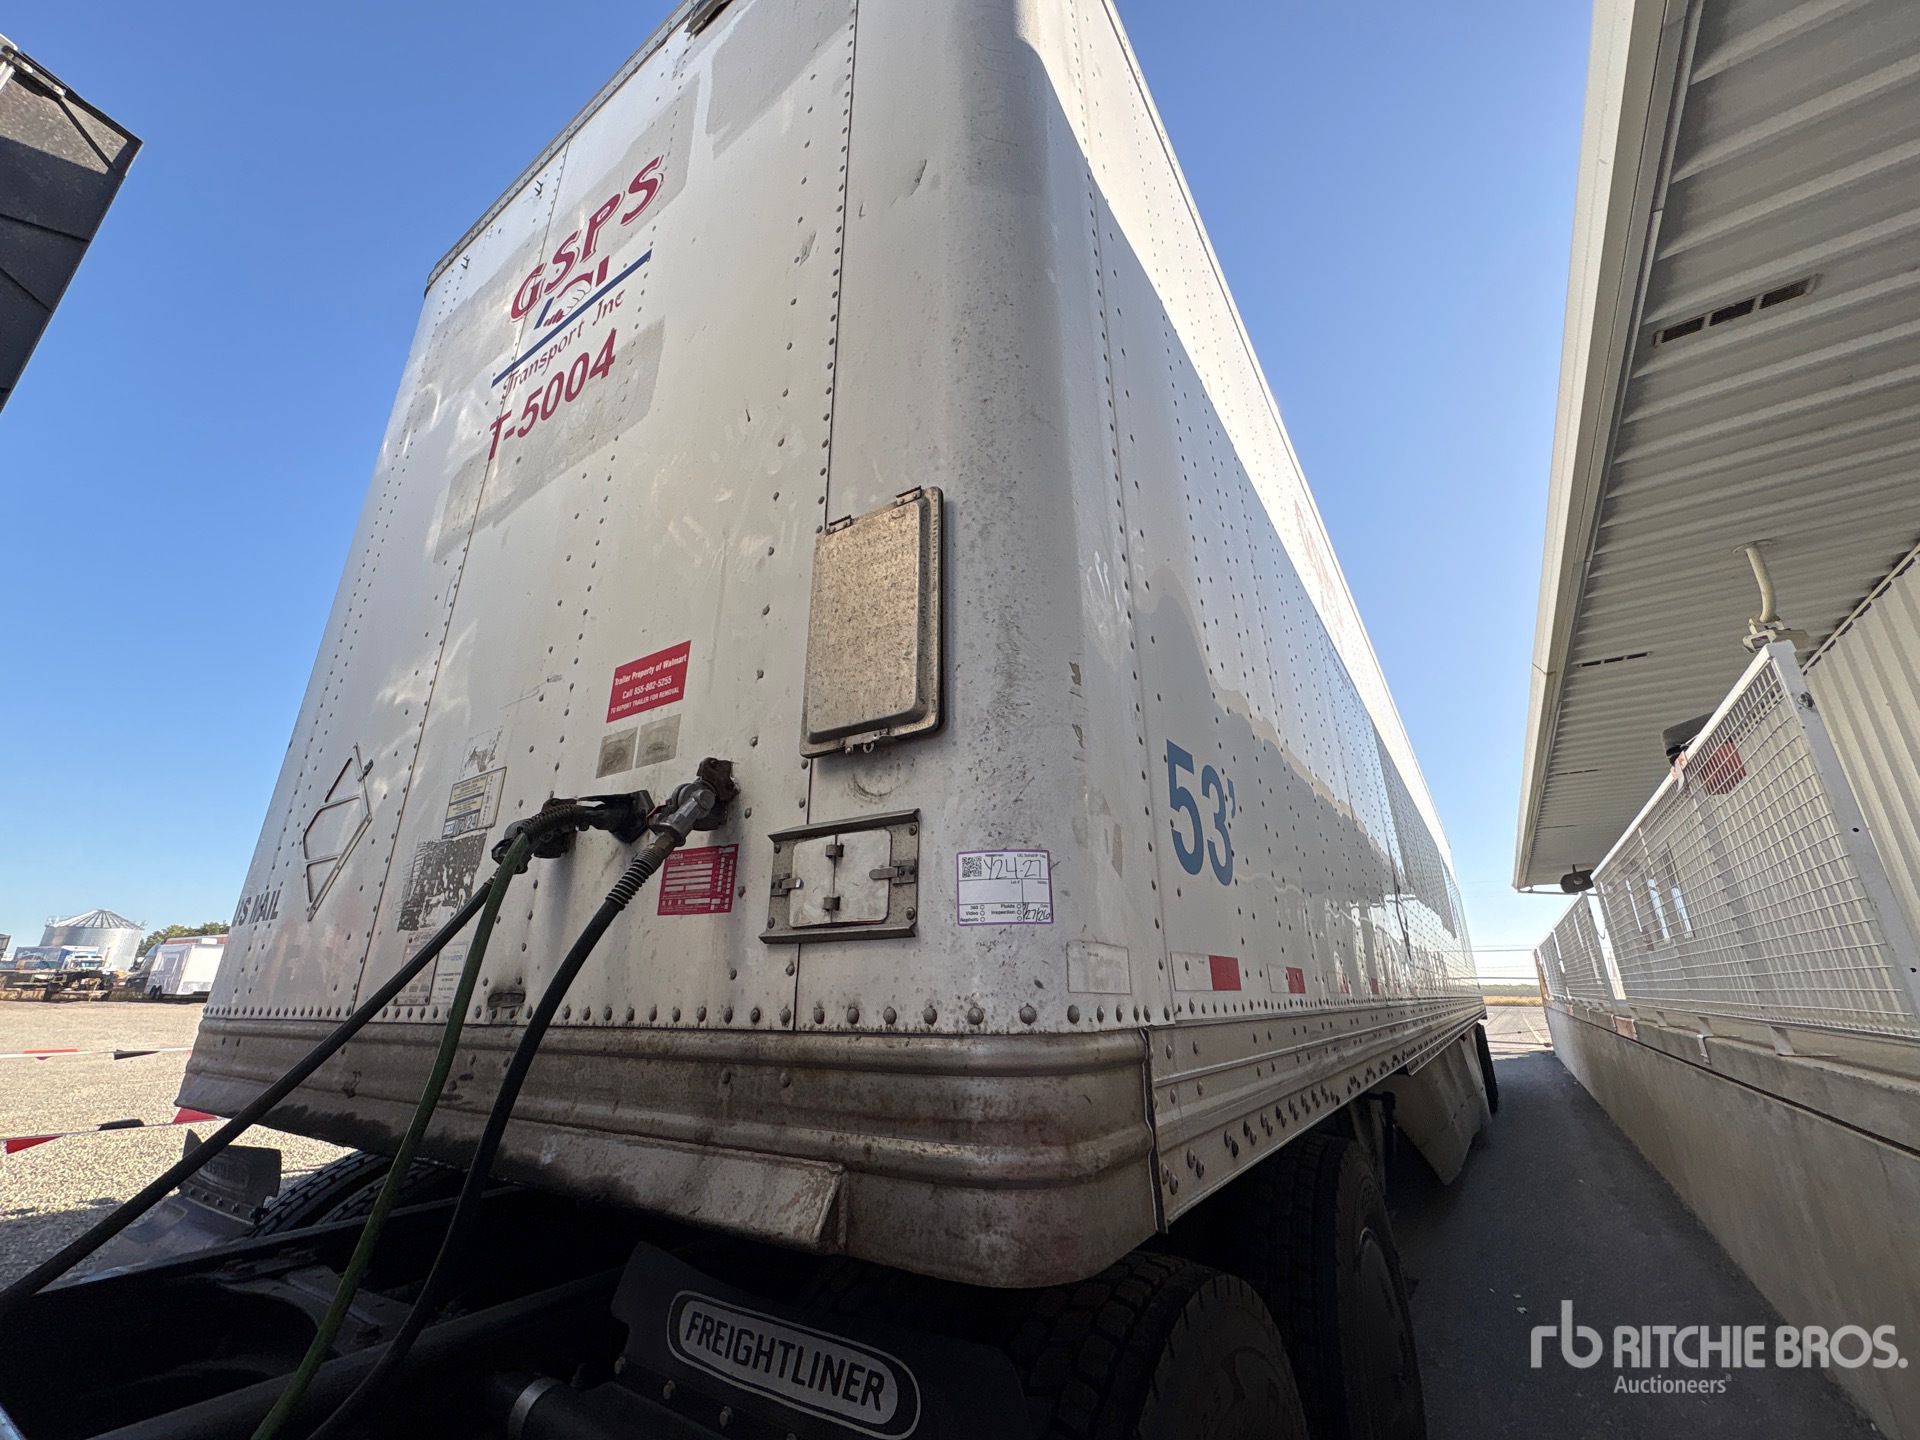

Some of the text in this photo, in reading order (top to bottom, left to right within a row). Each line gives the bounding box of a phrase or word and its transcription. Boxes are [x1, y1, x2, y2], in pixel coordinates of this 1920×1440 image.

[510, 155, 664, 322] GSPS
[502, 289, 625, 399] Transport Inc
[488, 328, 617, 461] T-5004
[615, 654, 687, 686] Trailer Property of Walmart
[616, 702, 632, 712] REPORT
[632, 696, 649, 706] TRAILER
[650, 693, 659, 702] FOR
[659, 687, 680, 698] REMOVAL
[622, 689, 633, 699] Call
[231, 889, 281, 927] US MAIL
[685, 1311, 885, 1412] FREIGHTLINER
